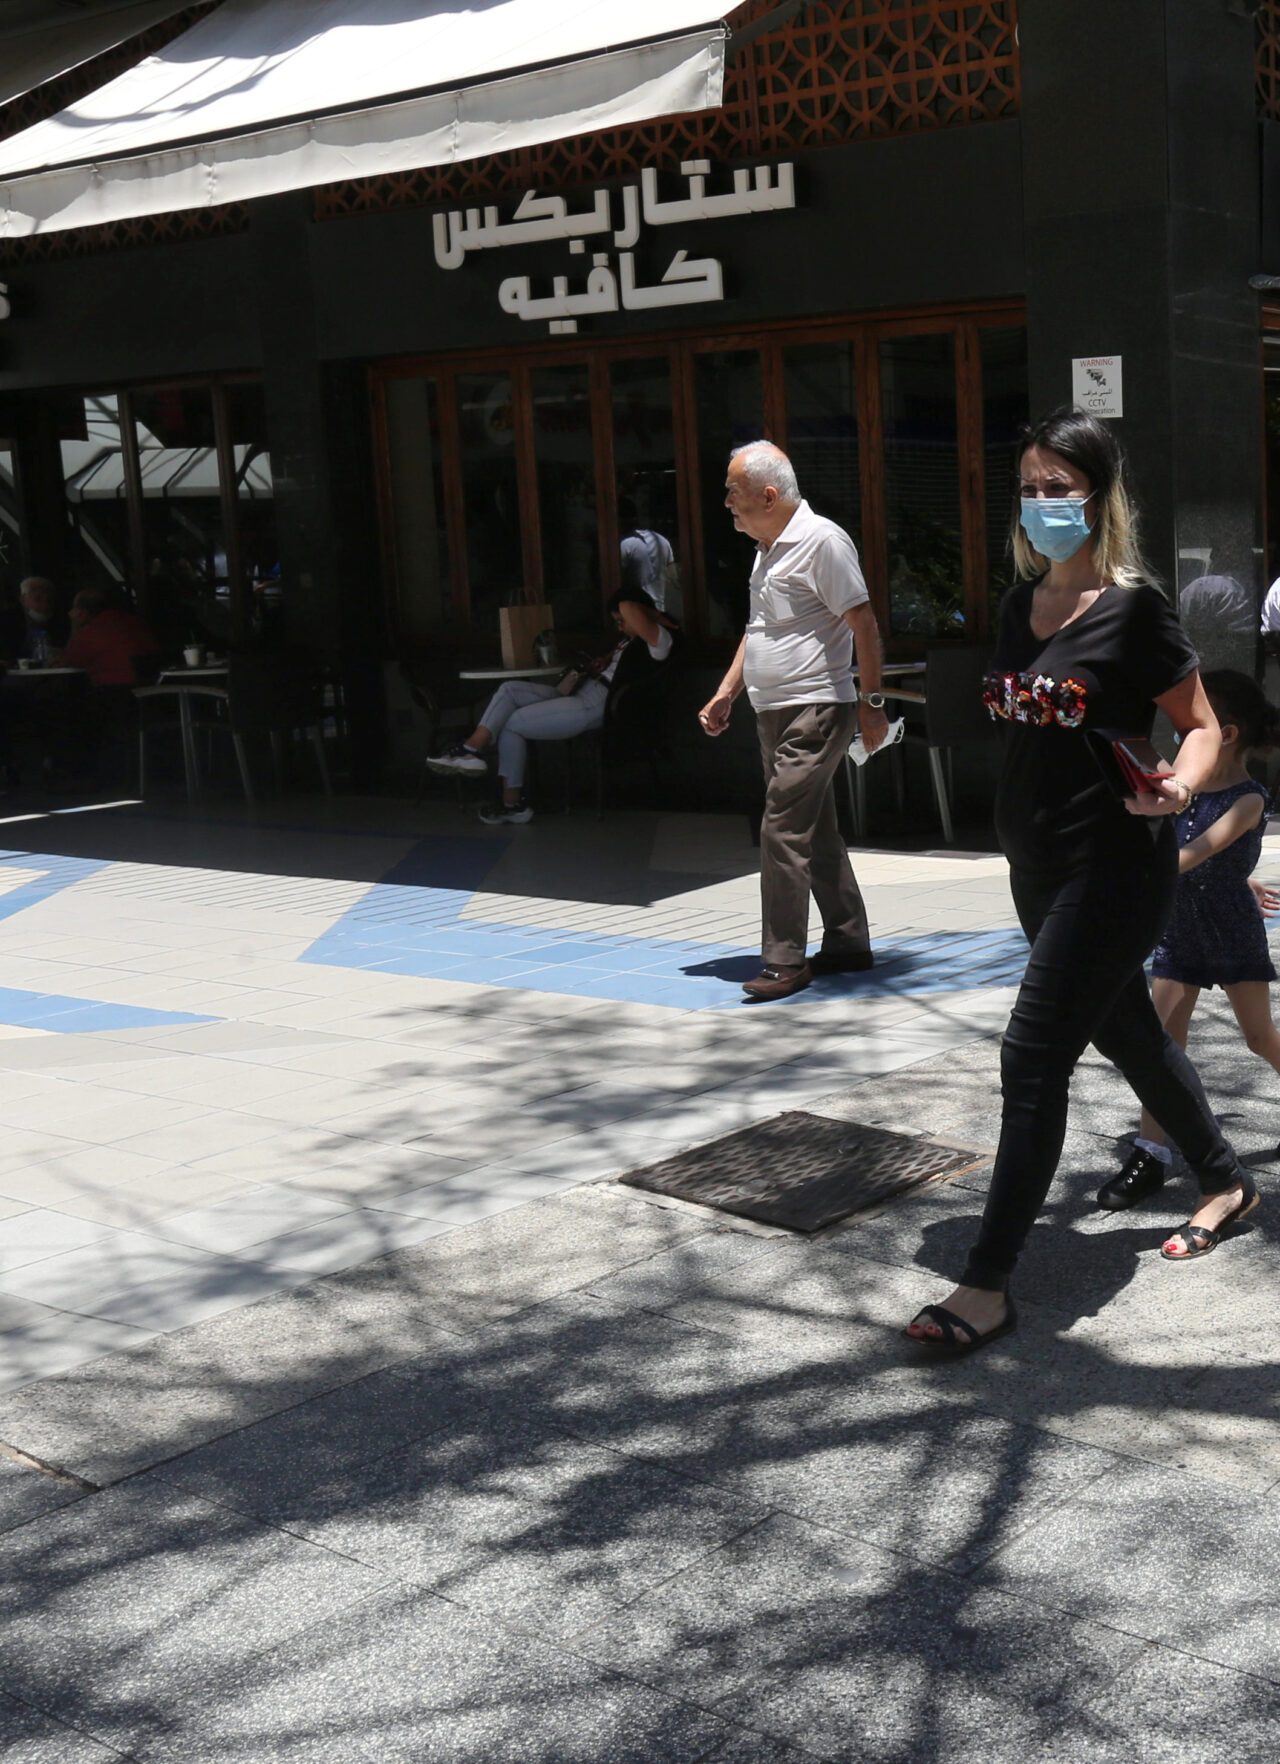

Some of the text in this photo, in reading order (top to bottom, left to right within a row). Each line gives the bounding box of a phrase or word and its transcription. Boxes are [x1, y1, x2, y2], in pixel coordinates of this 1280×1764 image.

[432, 159, 797, 270] ستاربكس
[498, 248, 725, 335] كافيه
[1080, 358, 1113, 367] WARNING
[1088, 399, 1106, 407] CCTV
